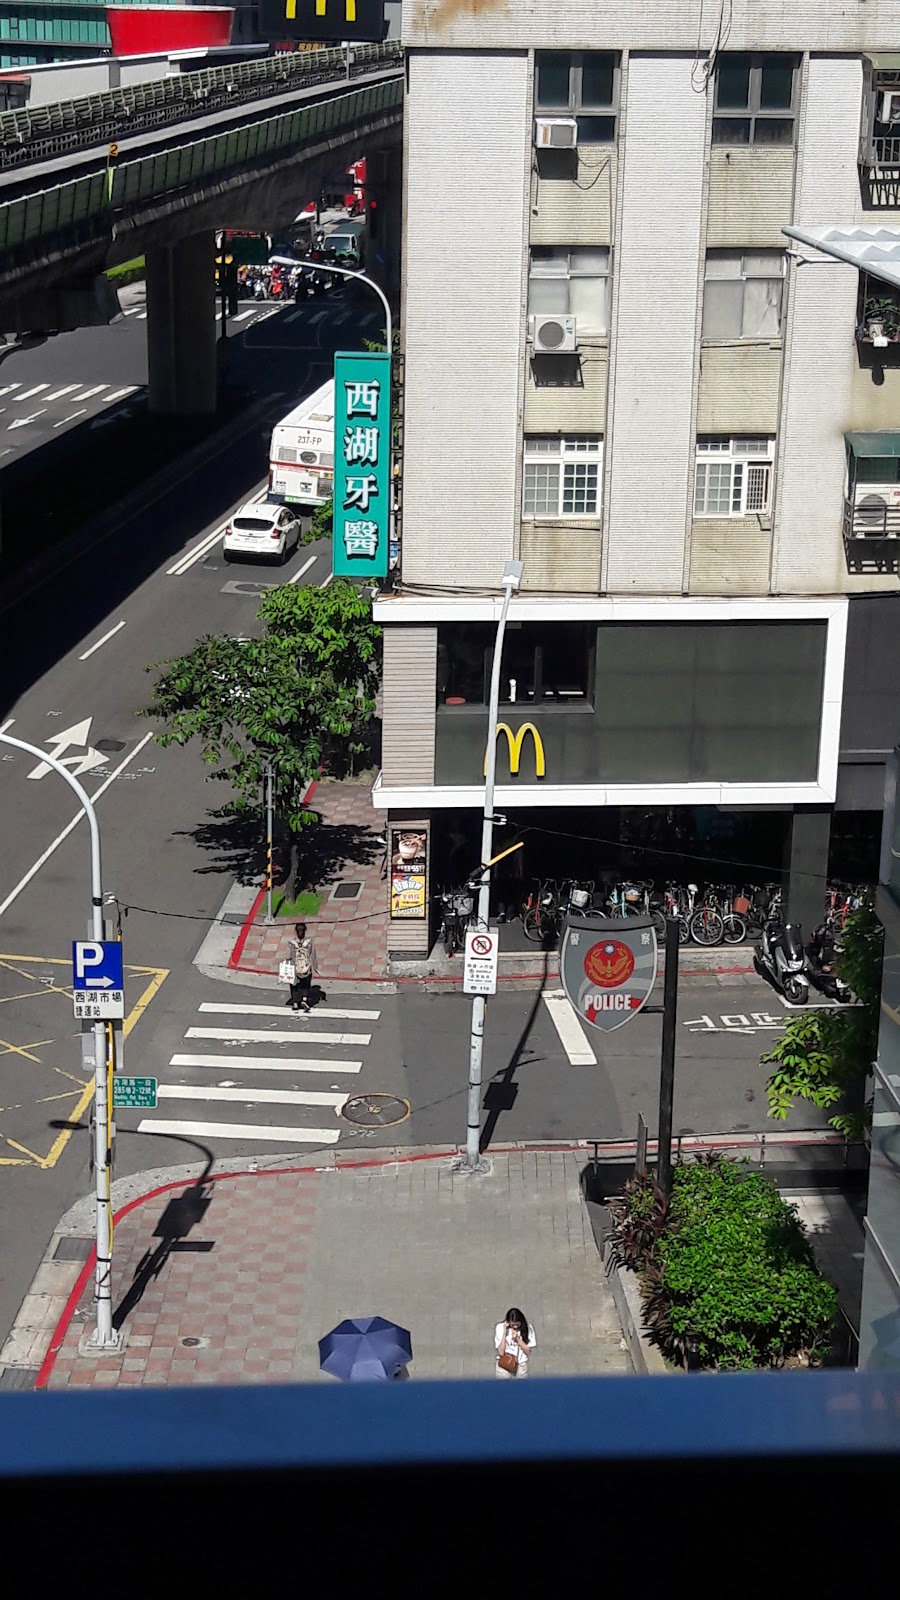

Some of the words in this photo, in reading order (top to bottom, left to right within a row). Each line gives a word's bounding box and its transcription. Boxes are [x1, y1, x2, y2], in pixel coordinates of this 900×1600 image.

[110, 144, 118, 155] 2
[297, 435, 322, 445] 237-FP
[344, 380, 380, 556] 西湖牙醫
[76, 942, 104, 978] P
[75, 991, 122, 1003] 西湖市場
[584, 994, 631, 1011] POLICE
